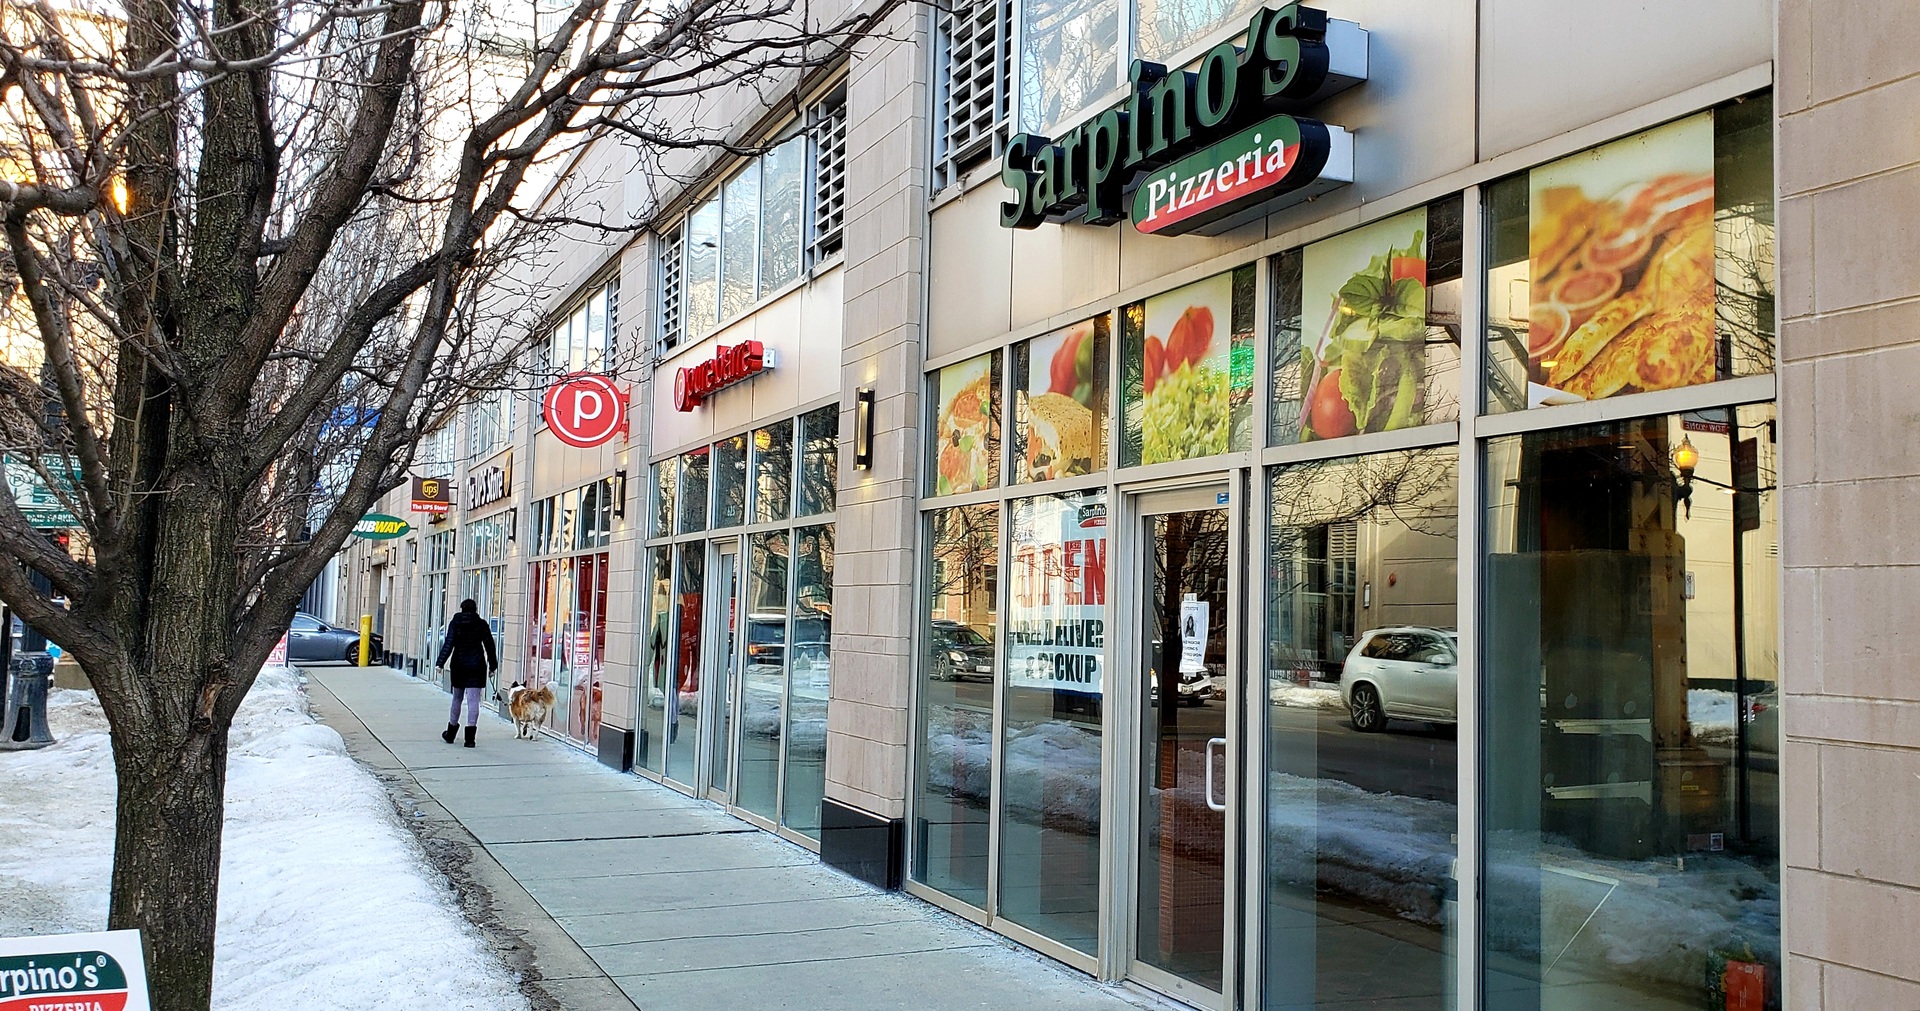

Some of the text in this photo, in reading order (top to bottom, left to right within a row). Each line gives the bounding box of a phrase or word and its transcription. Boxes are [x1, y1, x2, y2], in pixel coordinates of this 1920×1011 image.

[1000, 4, 1301, 228] Sarpino's
[1145, 132, 1287, 222] Pizzeria
[424, 486, 437, 496] ups
[486, 465, 504, 503] Store
[47, 513, 78, 523] PARKIN
[1037, 652, 1097, 684] PICKUP
